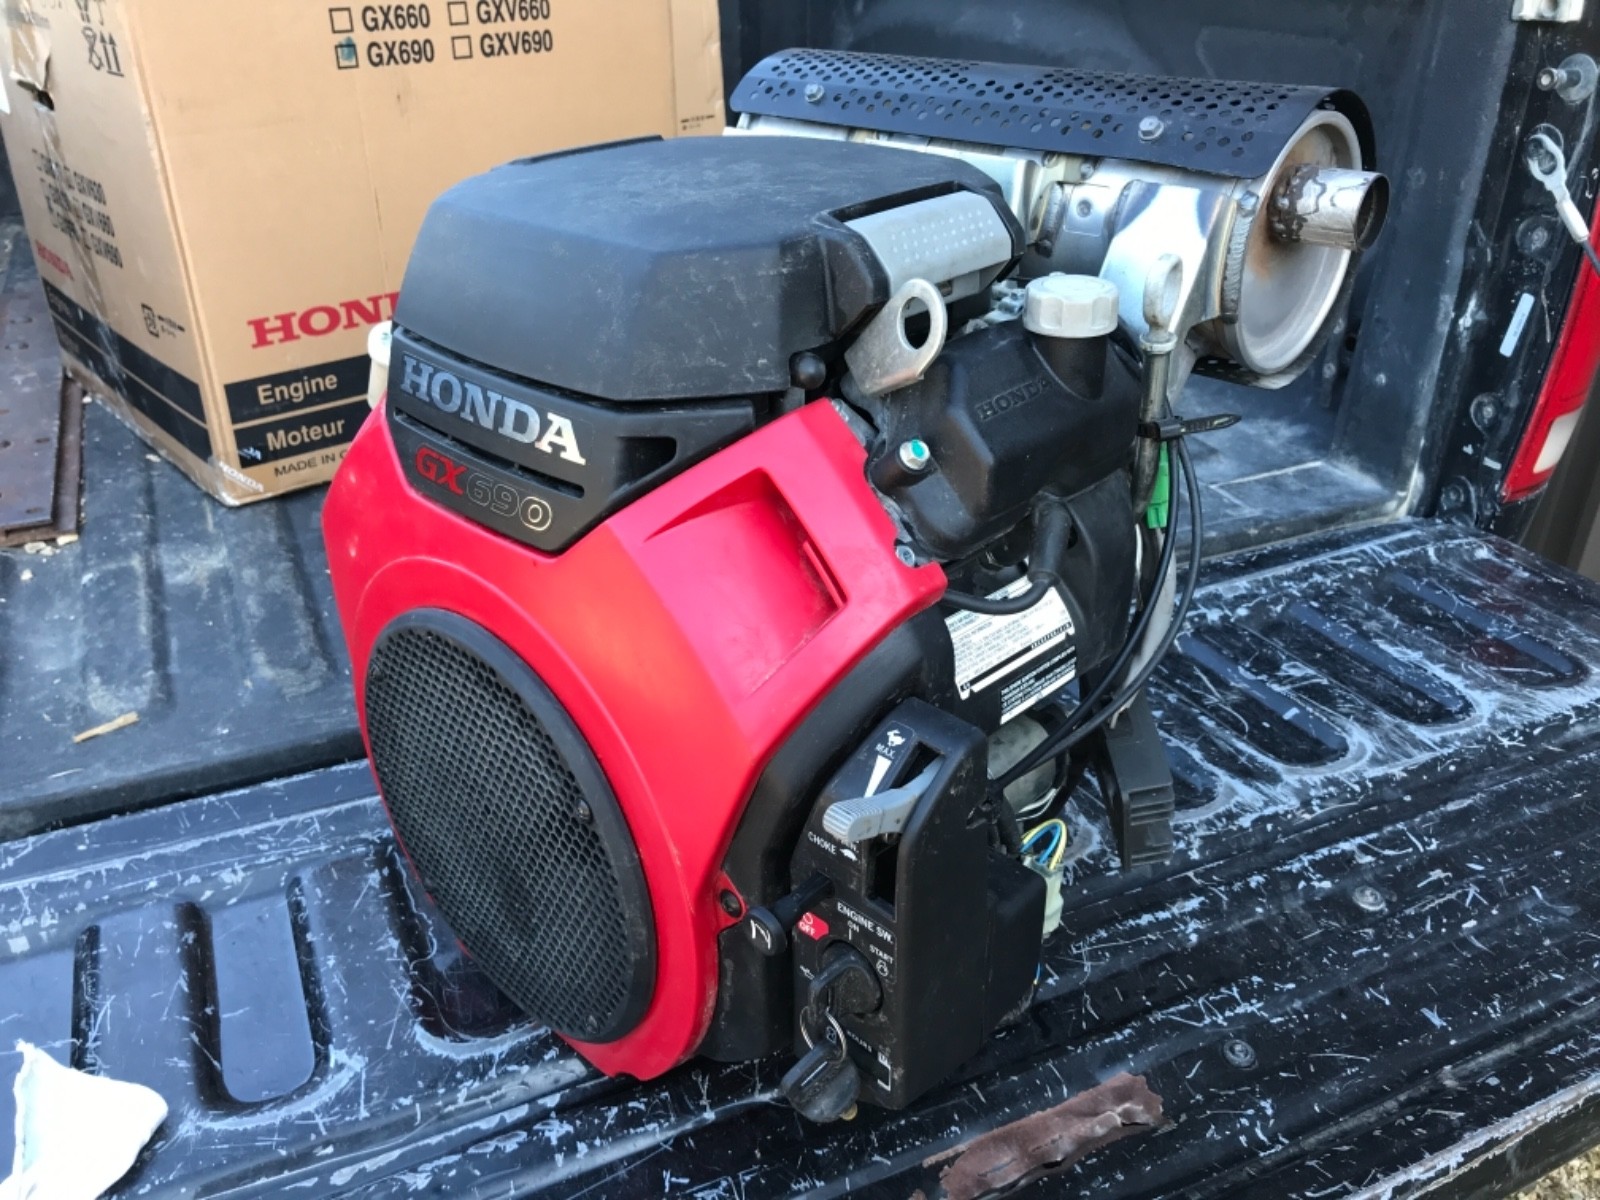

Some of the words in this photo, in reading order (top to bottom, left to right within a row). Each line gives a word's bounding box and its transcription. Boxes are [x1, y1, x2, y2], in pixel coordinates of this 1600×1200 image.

[361, 4, 431, 32] GX660
[476, 0, 551, 24] GXV660
[366, 38, 434, 67] GX690
[480, 29, 553, 58] GXV690
[257, 374, 338, 405] Engine
[401, 356, 586, 466] HONDA
[266, 418, 345, 451] Moteur
[274, 460, 318, 477] MADE
[321, 454, 336, 464] IN
[416, 446, 552, 531] GX690
[807, 831, 837, 855] CHOKE
[798, 920, 816, 936] OFF
[837, 901, 875, 933] ENGINE
[847, 919, 860, 933] ON
[869, 944, 894, 965] START
